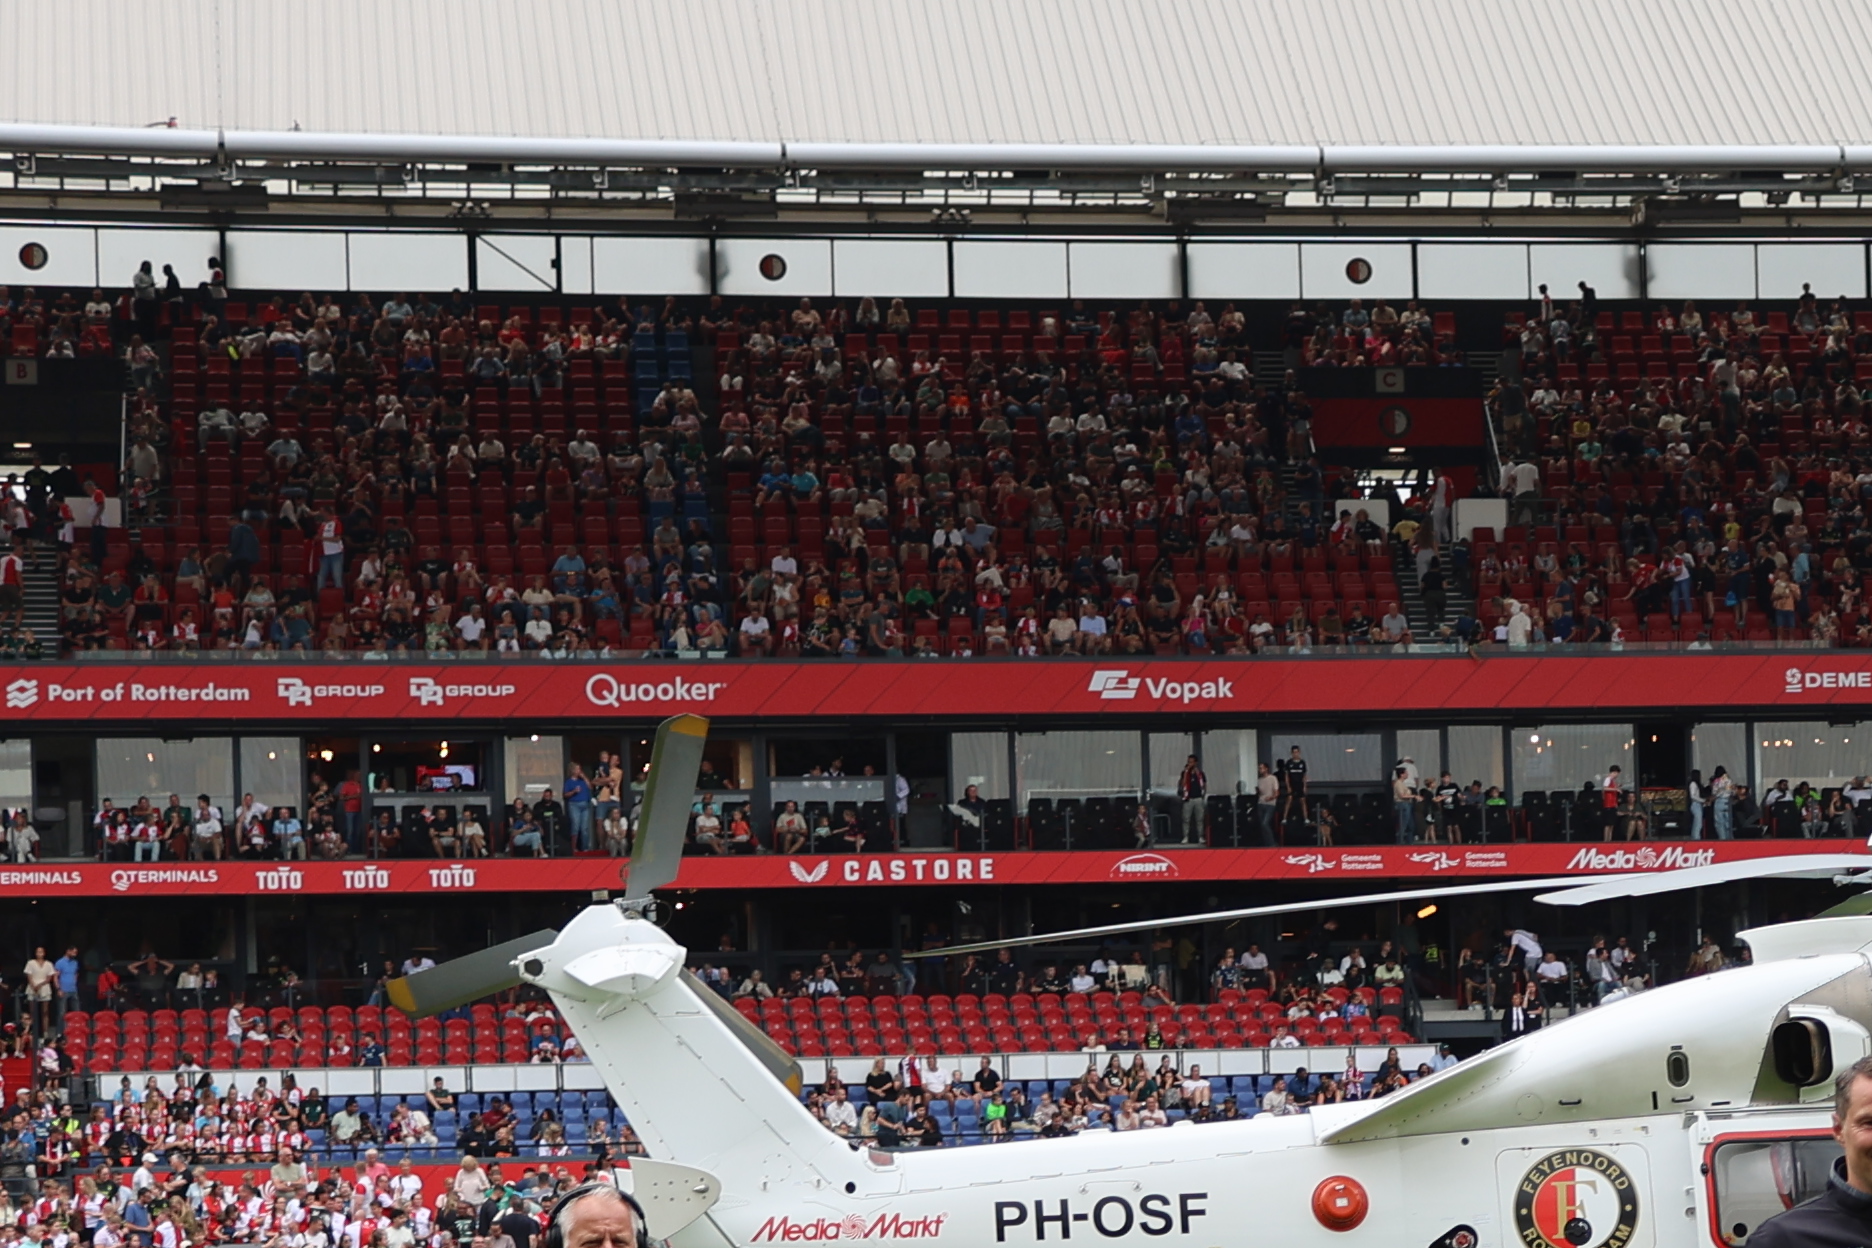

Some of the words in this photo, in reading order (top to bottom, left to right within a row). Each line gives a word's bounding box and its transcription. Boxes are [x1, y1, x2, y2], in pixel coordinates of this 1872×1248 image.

[16, 363, 28, 379] B
[1383, 372, 1397, 388] C
[313, 685, 386, 697] GROUP
[445, 684, 516, 697] GROUP
[585, 673, 718, 708] Quooker
[1144, 676, 1234, 704] Vopak
[1804, 671, 1872, 688] DEME
[47, 685, 95, 702] Port
[100, 682, 125, 702] of
[130, 682, 251, 702] Rotterdam
[1341, 862, 1384, 870] Rotterdam
[1567, 848, 1636, 869] Media
[1655, 847, 1716, 868] Markt
[0, 871, 82, 885] ERMINALS
[255, 866, 302, 890] TOTO
[342, 865, 389, 889] TOTO
[429, 863, 475, 888] TOTO
[844, 858, 994, 882] CASTORE
[1522, 1152, 1629, 1194] FEYENOORD
[751, 1215, 843, 1242] Media
[862, 1213, 947, 1239] Markt
[995, 1192, 1208, 1243] PH-OSF
